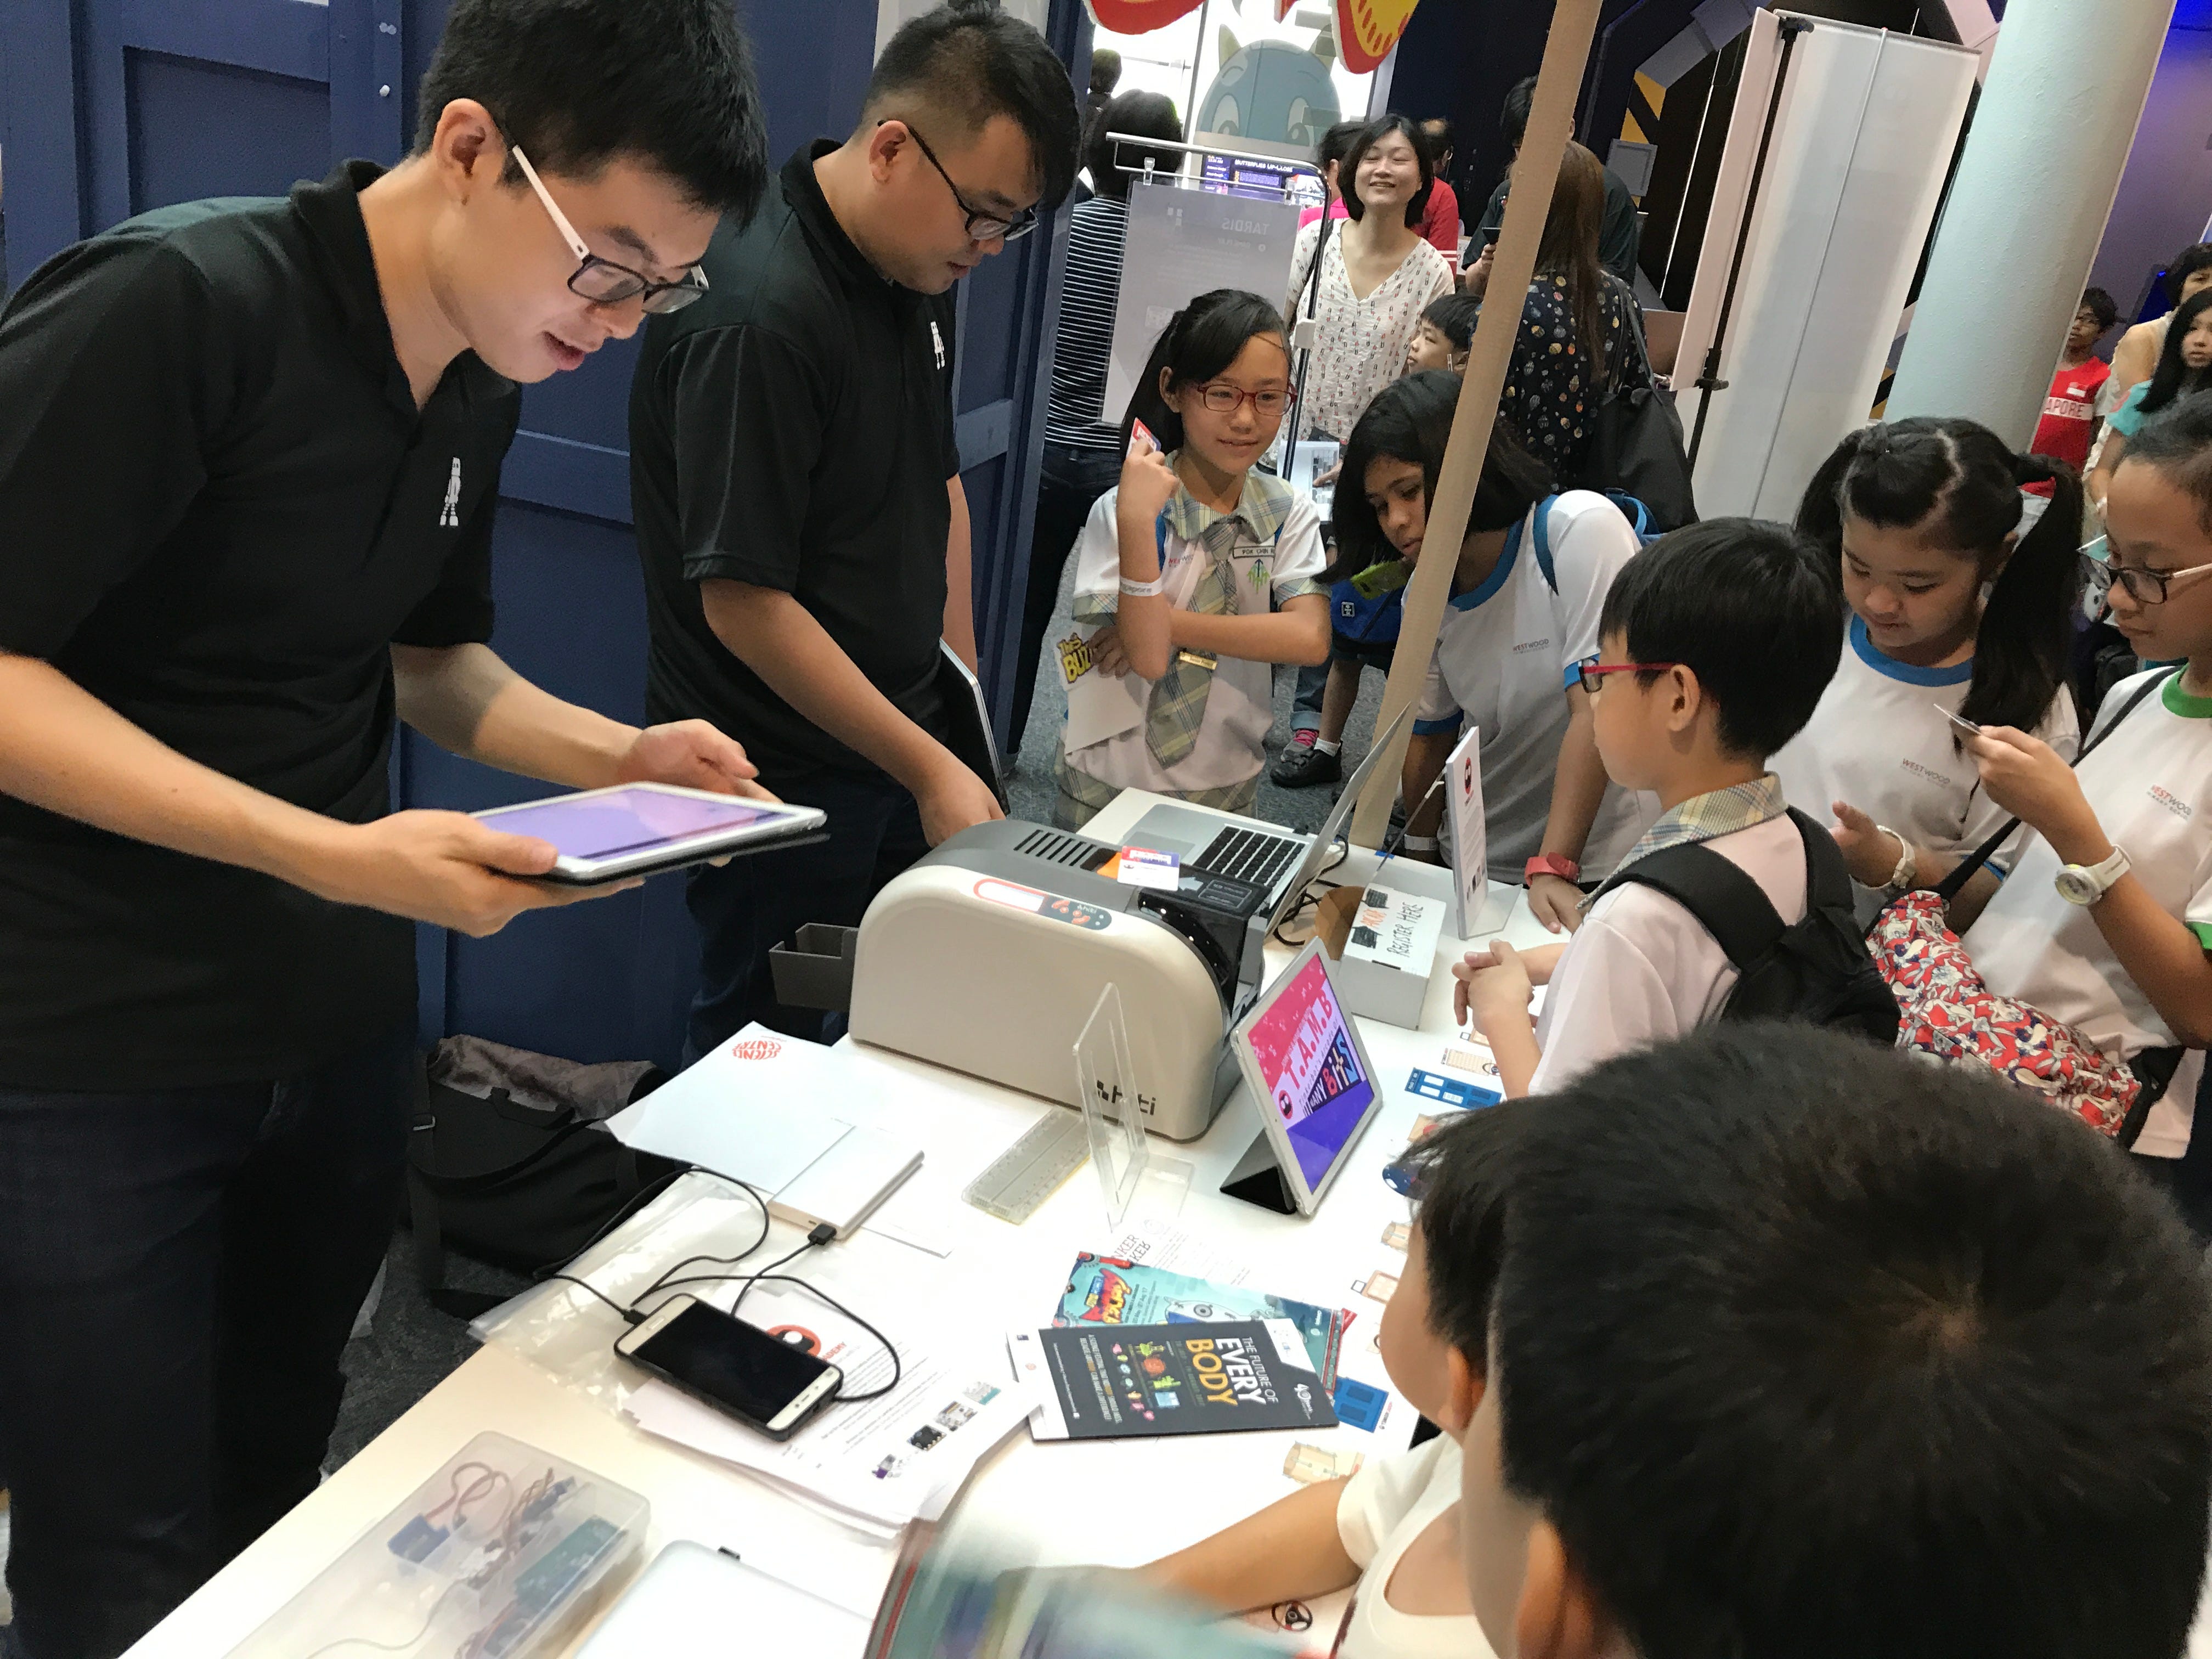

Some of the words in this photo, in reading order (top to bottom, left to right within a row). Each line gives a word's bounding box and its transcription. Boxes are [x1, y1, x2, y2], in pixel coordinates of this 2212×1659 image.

[2045, 398, 2085, 417] APORE
[1513, 639, 1549, 652] WESTWOOD
[1902, 758, 1951, 785] WESTWOOD
[1396, 901, 1424, 924] HERE
[1386, 923, 1414, 958] REGISTER
[732, 1048, 780, 1060] SCIENCE
[734, 1040, 782, 1050] CENTRE
[1111, 1085, 1156, 1116] hti
[1111, 1234, 1139, 1259] NKER
[1128, 1240, 1151, 1262] KER
[822, 1341, 847, 1362] ADEMY
[1242, 1336, 1257, 1353] THE
[1186, 1339, 1238, 1407] BODY
[1215, 1338, 1267, 1405] EVERY
[1249, 1355, 1272, 1388] FUTURE
[1264, 1389, 1279, 1404] OF
